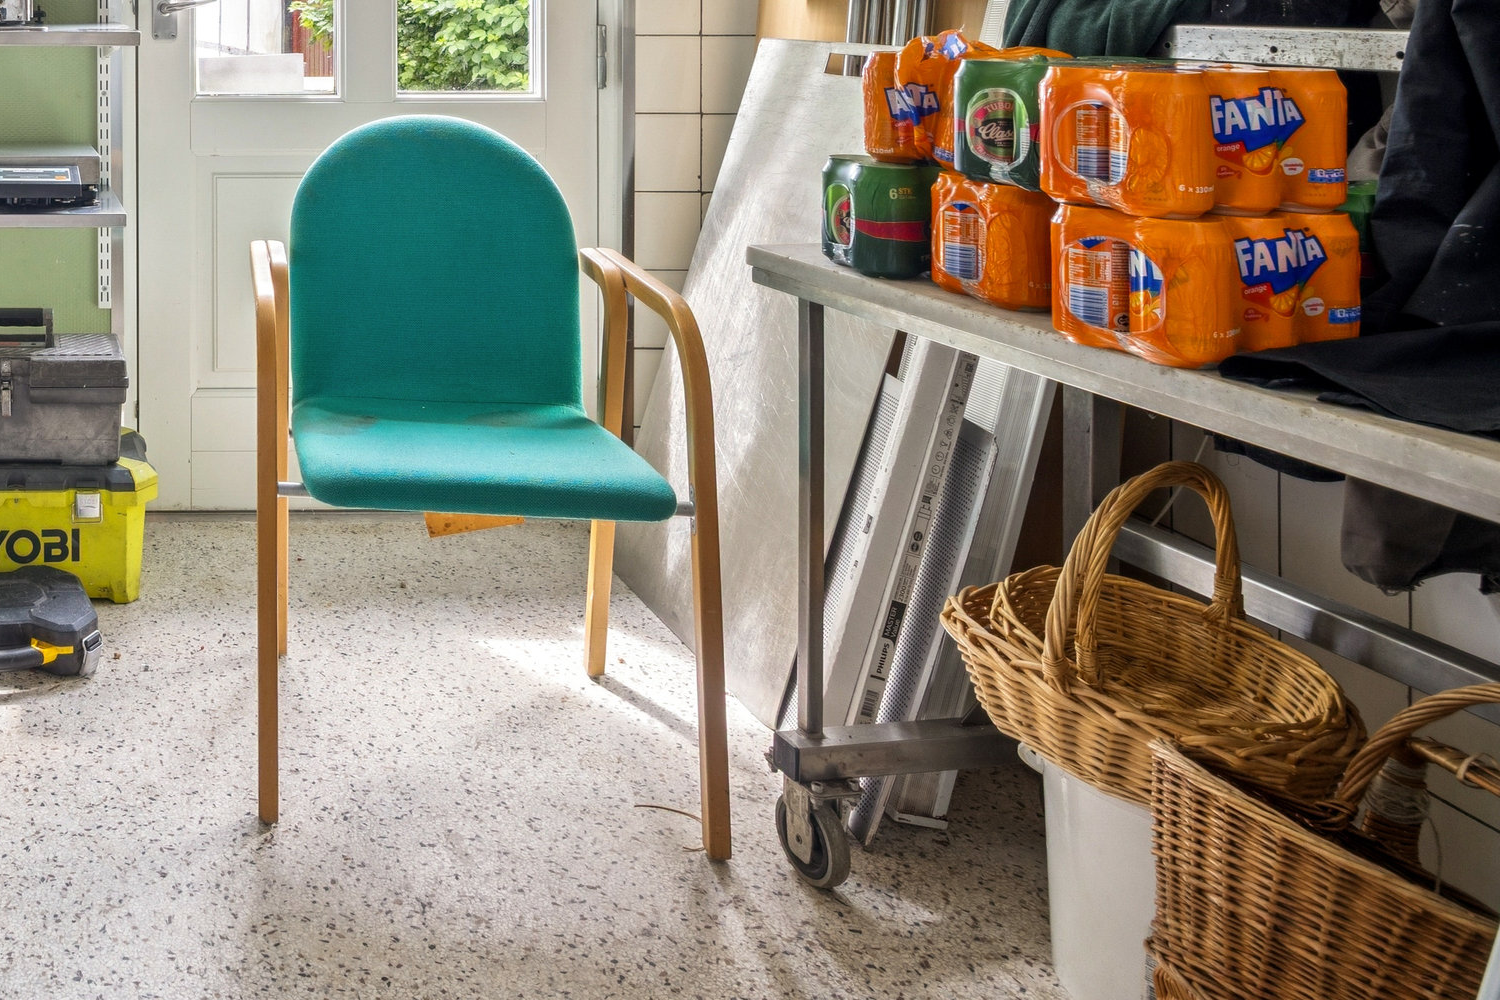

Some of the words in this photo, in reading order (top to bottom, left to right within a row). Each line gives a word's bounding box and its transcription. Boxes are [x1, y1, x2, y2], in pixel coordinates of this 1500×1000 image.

[984, 101, 1014, 113] TUBO
[1210, 89, 1302, 136] FANTA
[1216, 144, 1241, 153] orange
[889, 188, 898, 199] 6
[1178, 184, 1186, 192] 6
[1234, 231, 1323, 277] FANTA
[1244, 284, 1268, 295] orange
[1213, 331, 1218, 339] 6
[877, 643, 890, 674] PHILIPS
